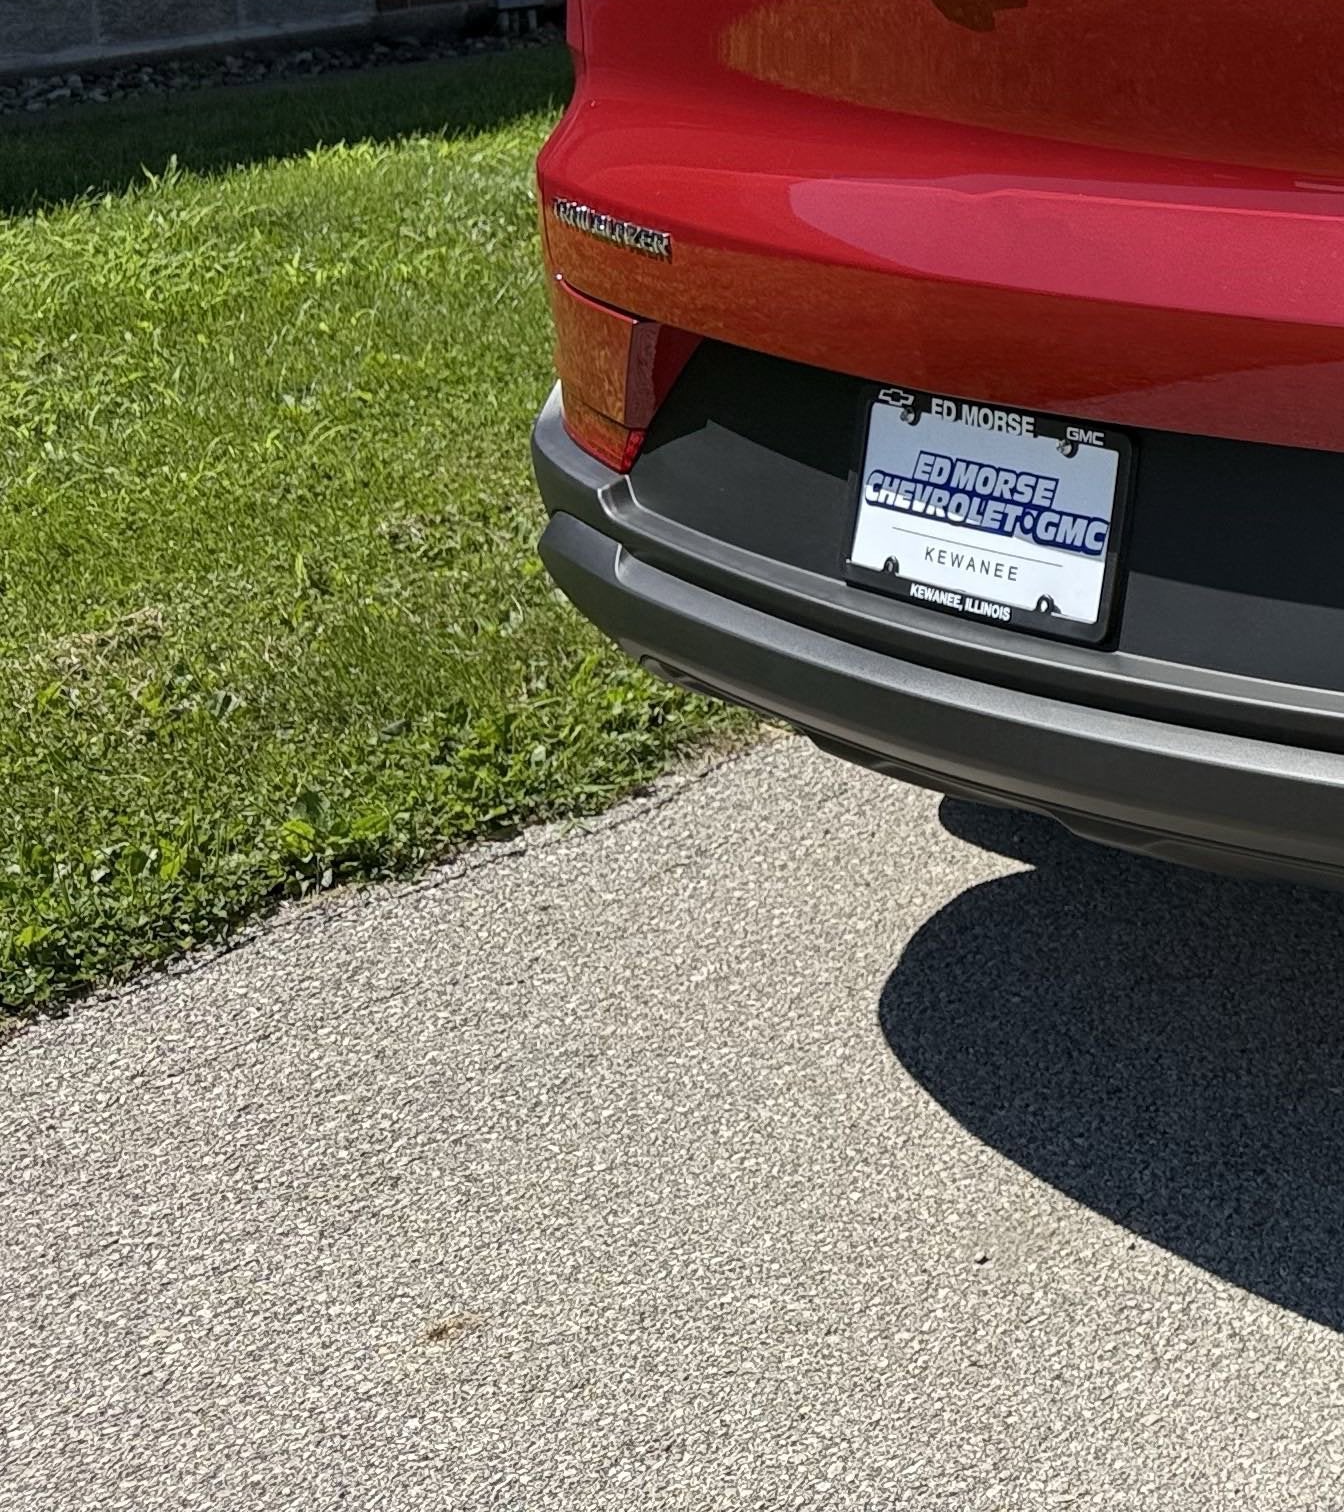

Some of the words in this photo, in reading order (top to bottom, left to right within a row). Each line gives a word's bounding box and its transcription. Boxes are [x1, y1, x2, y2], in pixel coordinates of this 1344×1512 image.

[931, 397, 956, 422] ED
[961, 404, 1035, 437] MORSE
[1066, 426, 1104, 446] GMC
[913, 451, 953, 486] ED
[950, 458, 1059, 509] MORSE
[924, 546, 1018, 581] KEWANEE
[909, 583, 962, 611] KEWANEE,
[964, 598, 1011, 622] ILLINOIS
